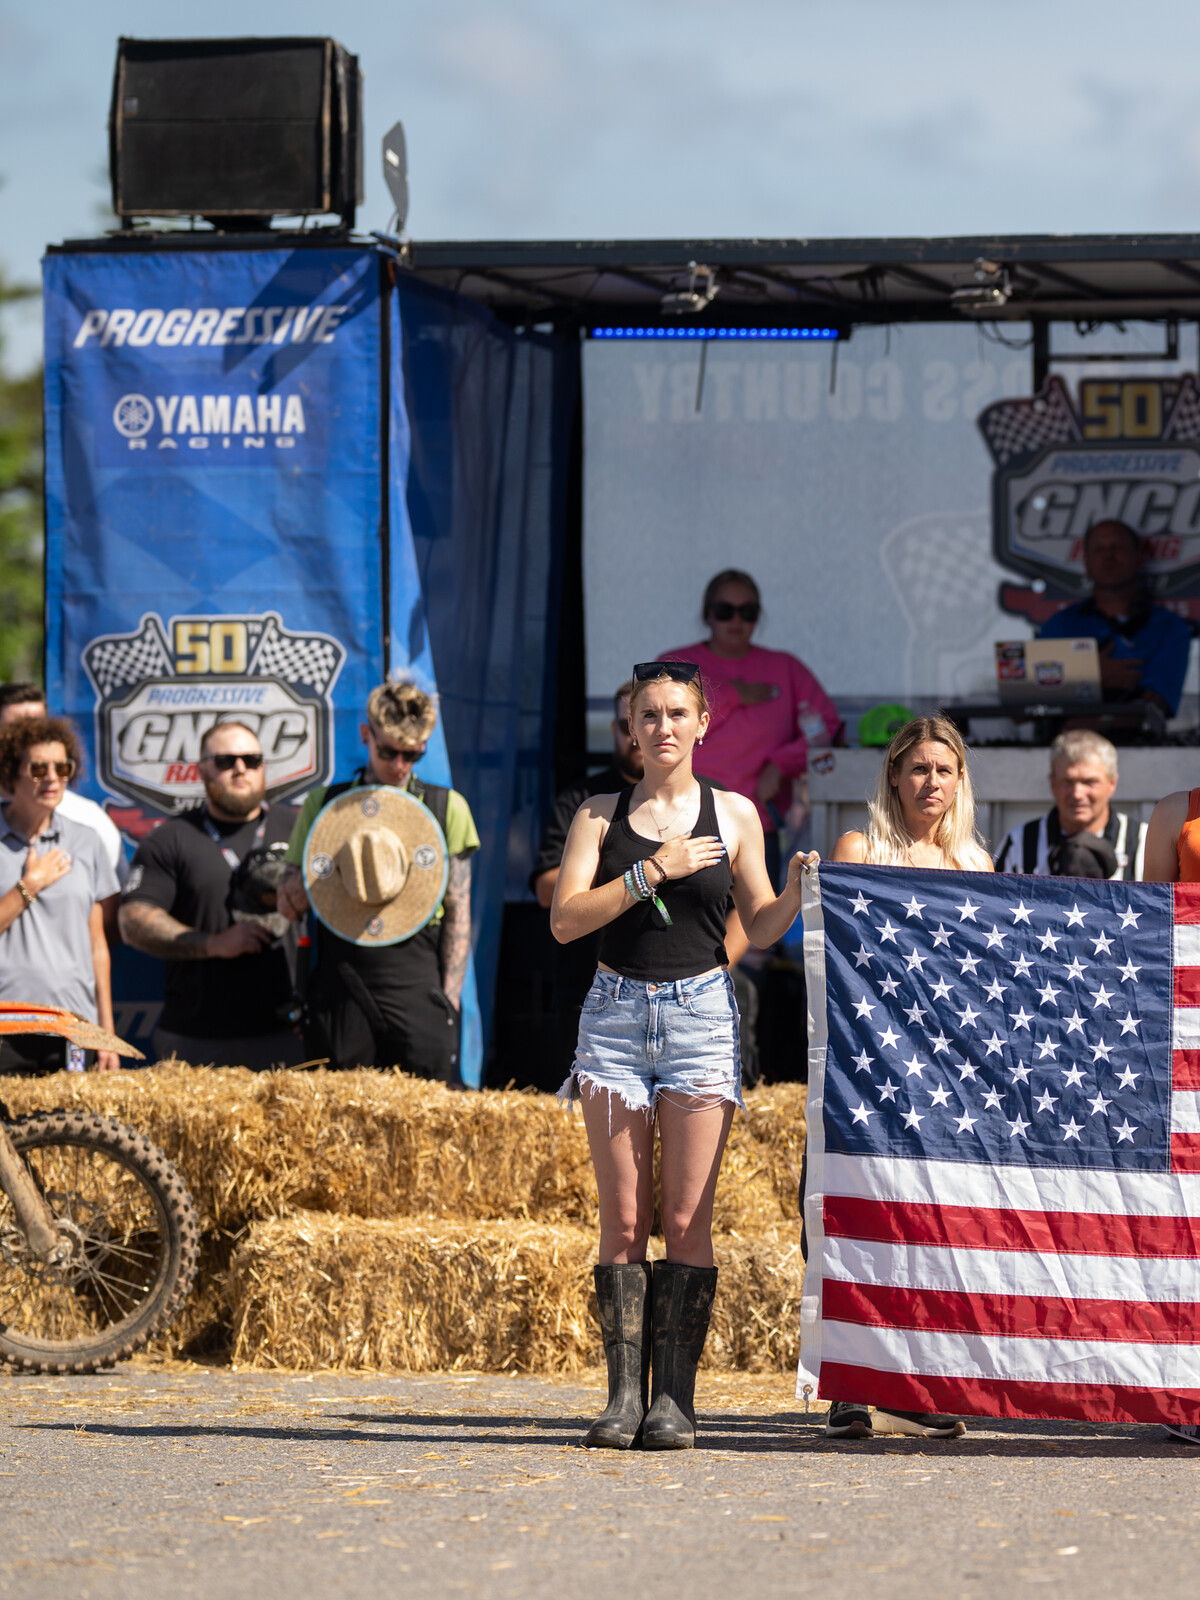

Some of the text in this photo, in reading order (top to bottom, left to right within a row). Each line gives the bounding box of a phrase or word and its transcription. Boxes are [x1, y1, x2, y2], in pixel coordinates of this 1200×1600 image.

[73, 304, 345, 350] PROGRESSIVE
[156, 394, 307, 435] YAMAHA
[1083, 382, 1162, 438] 50
[129, 438, 296, 449] RACING
[1050, 453, 1183, 473] PROGRESSIVE
[175, 622, 248, 674] 50
[146, 685, 267, 705] PROGRESSIVE
[118, 710, 309, 765] GNC
